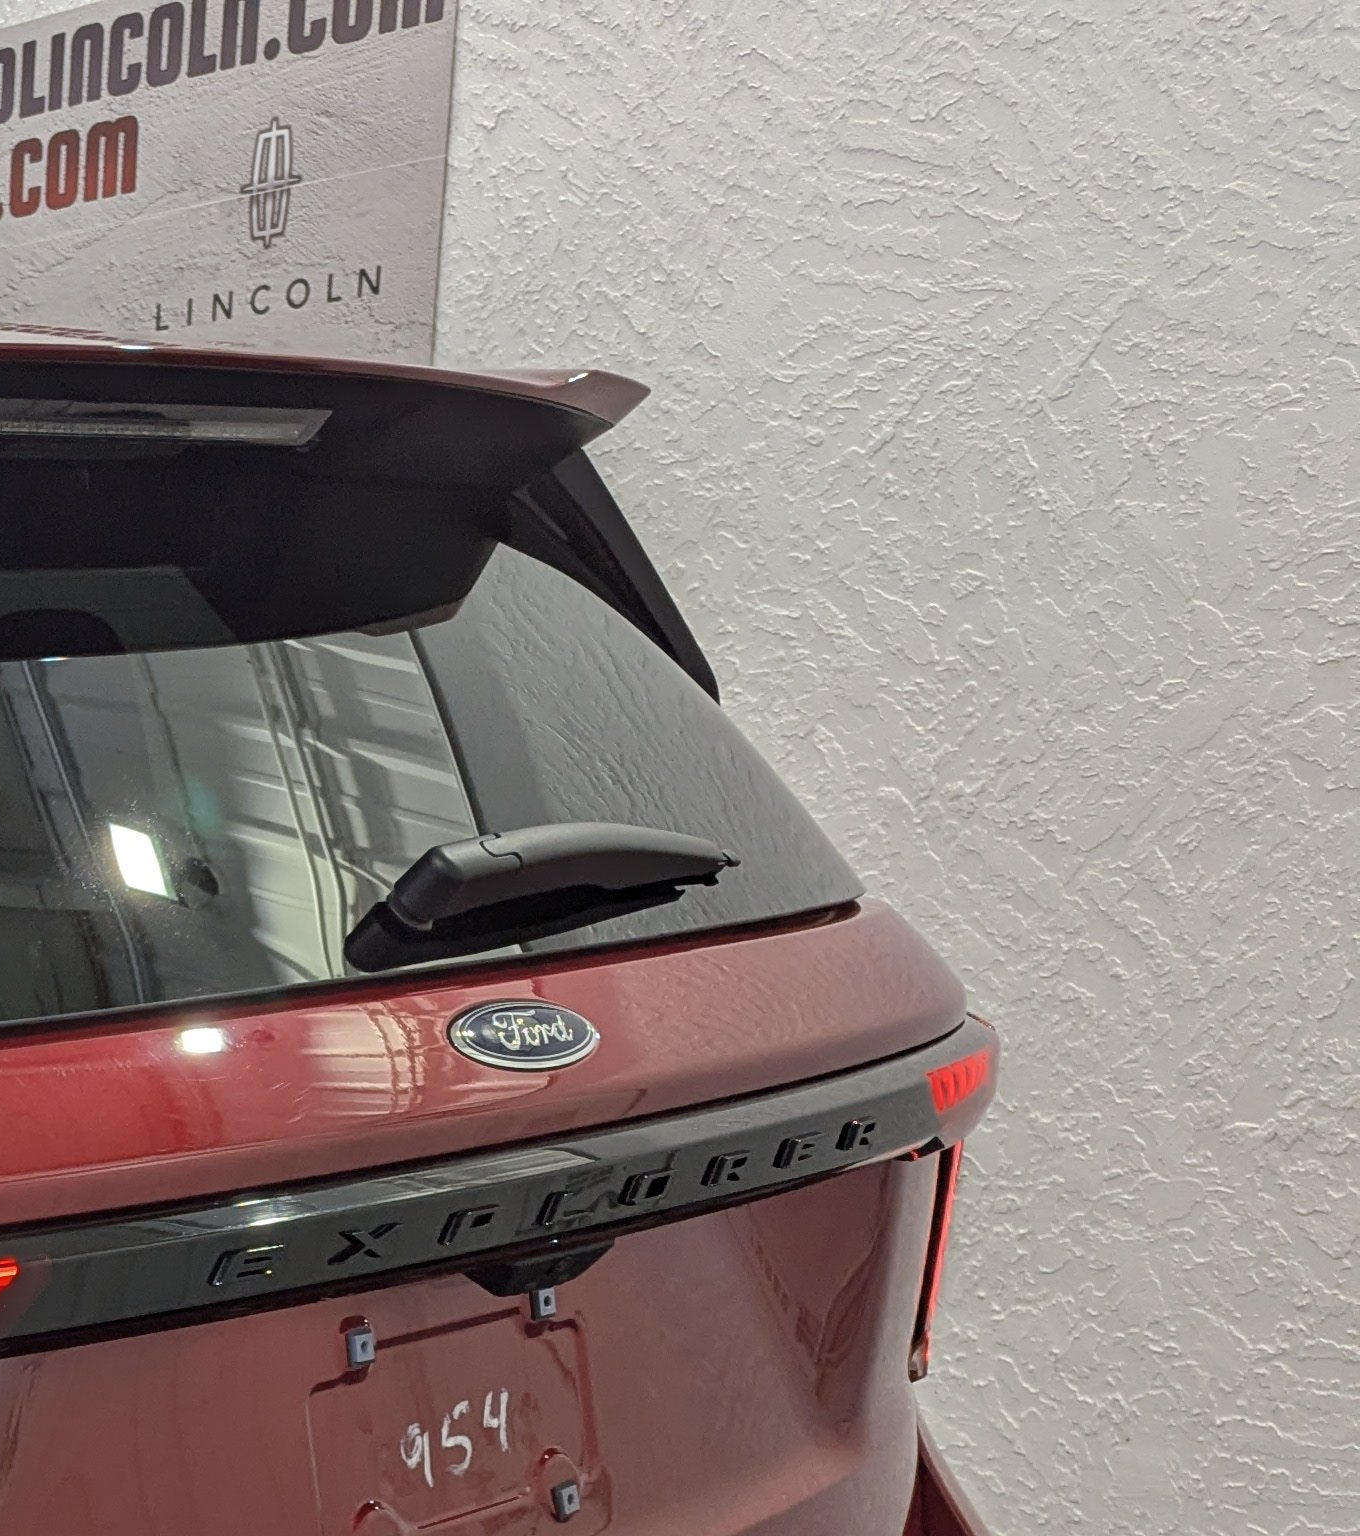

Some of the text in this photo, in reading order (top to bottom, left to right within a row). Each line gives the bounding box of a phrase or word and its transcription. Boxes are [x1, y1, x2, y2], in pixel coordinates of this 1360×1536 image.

[154, 264, 382, 331] LINCOLN
[491, 1008, 574, 1051] Ford
[206, 1114, 877, 1287] EXPLORER
[400, 1386, 510, 1488] 954
